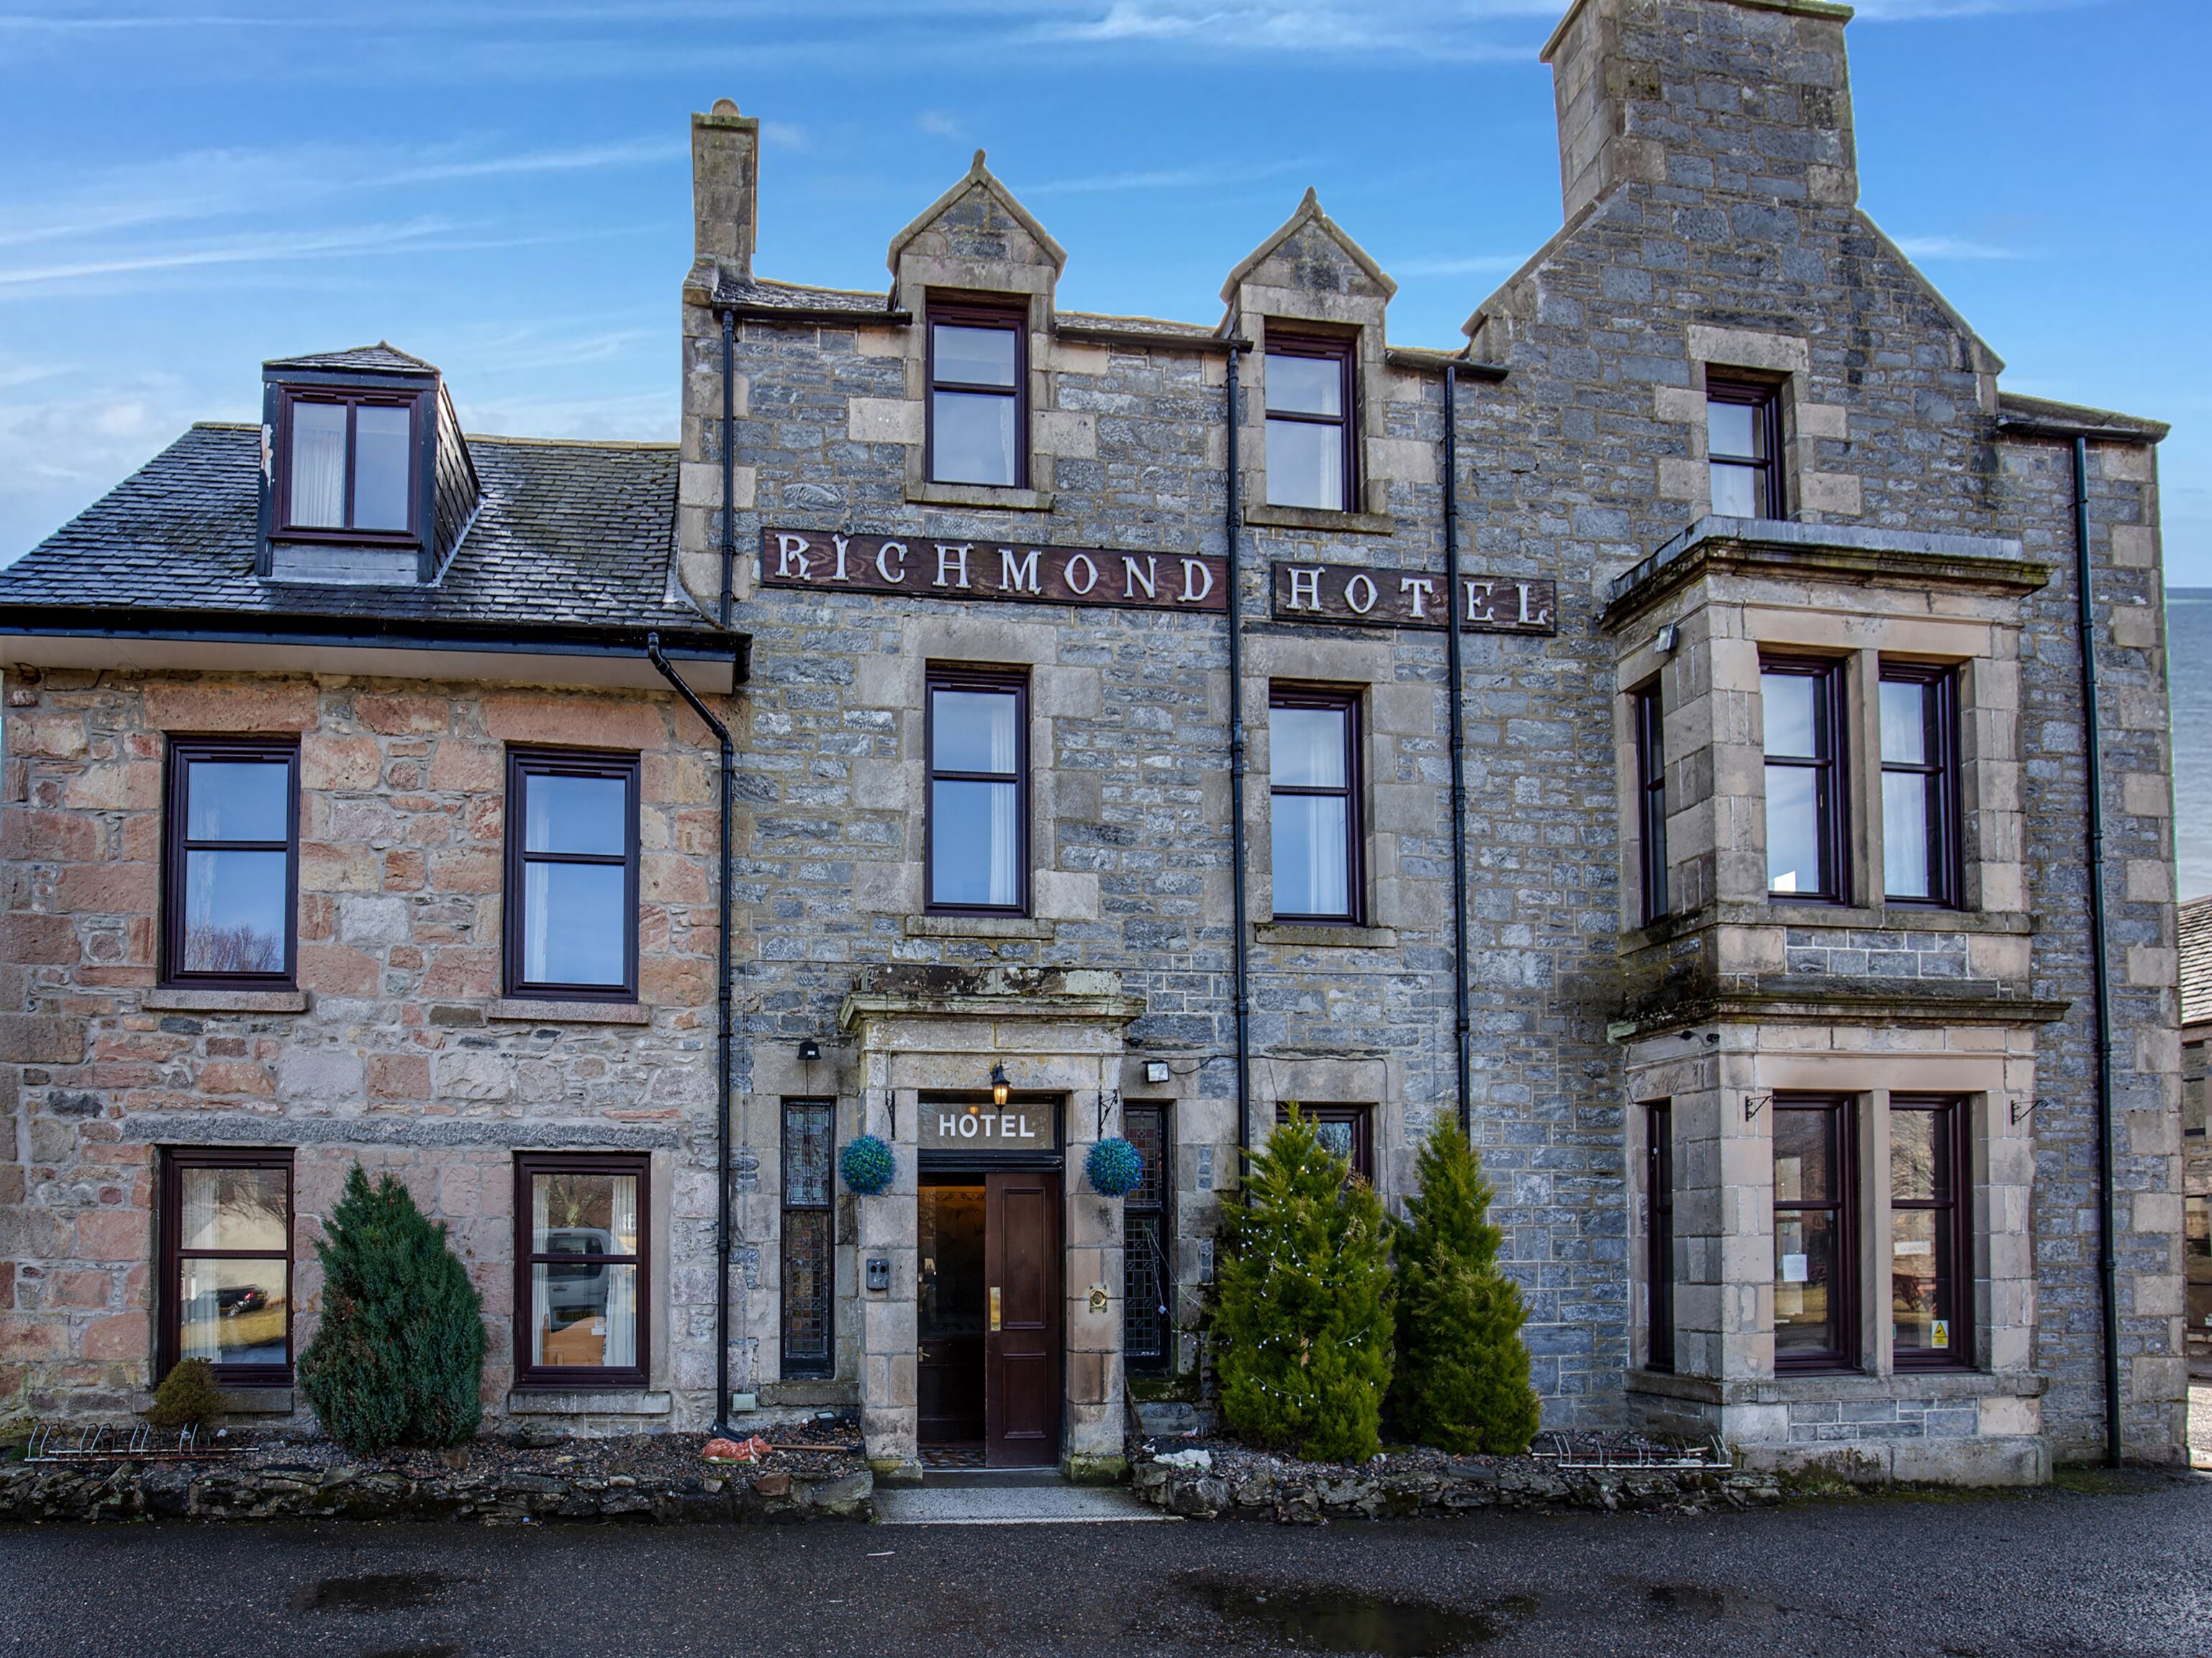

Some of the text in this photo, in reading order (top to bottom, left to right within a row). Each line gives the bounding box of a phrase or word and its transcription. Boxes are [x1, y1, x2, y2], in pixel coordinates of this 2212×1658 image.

[774, 533, 1548, 625] RICHMOND HOTEL
[939, 1113, 1035, 1138] HOTEL
